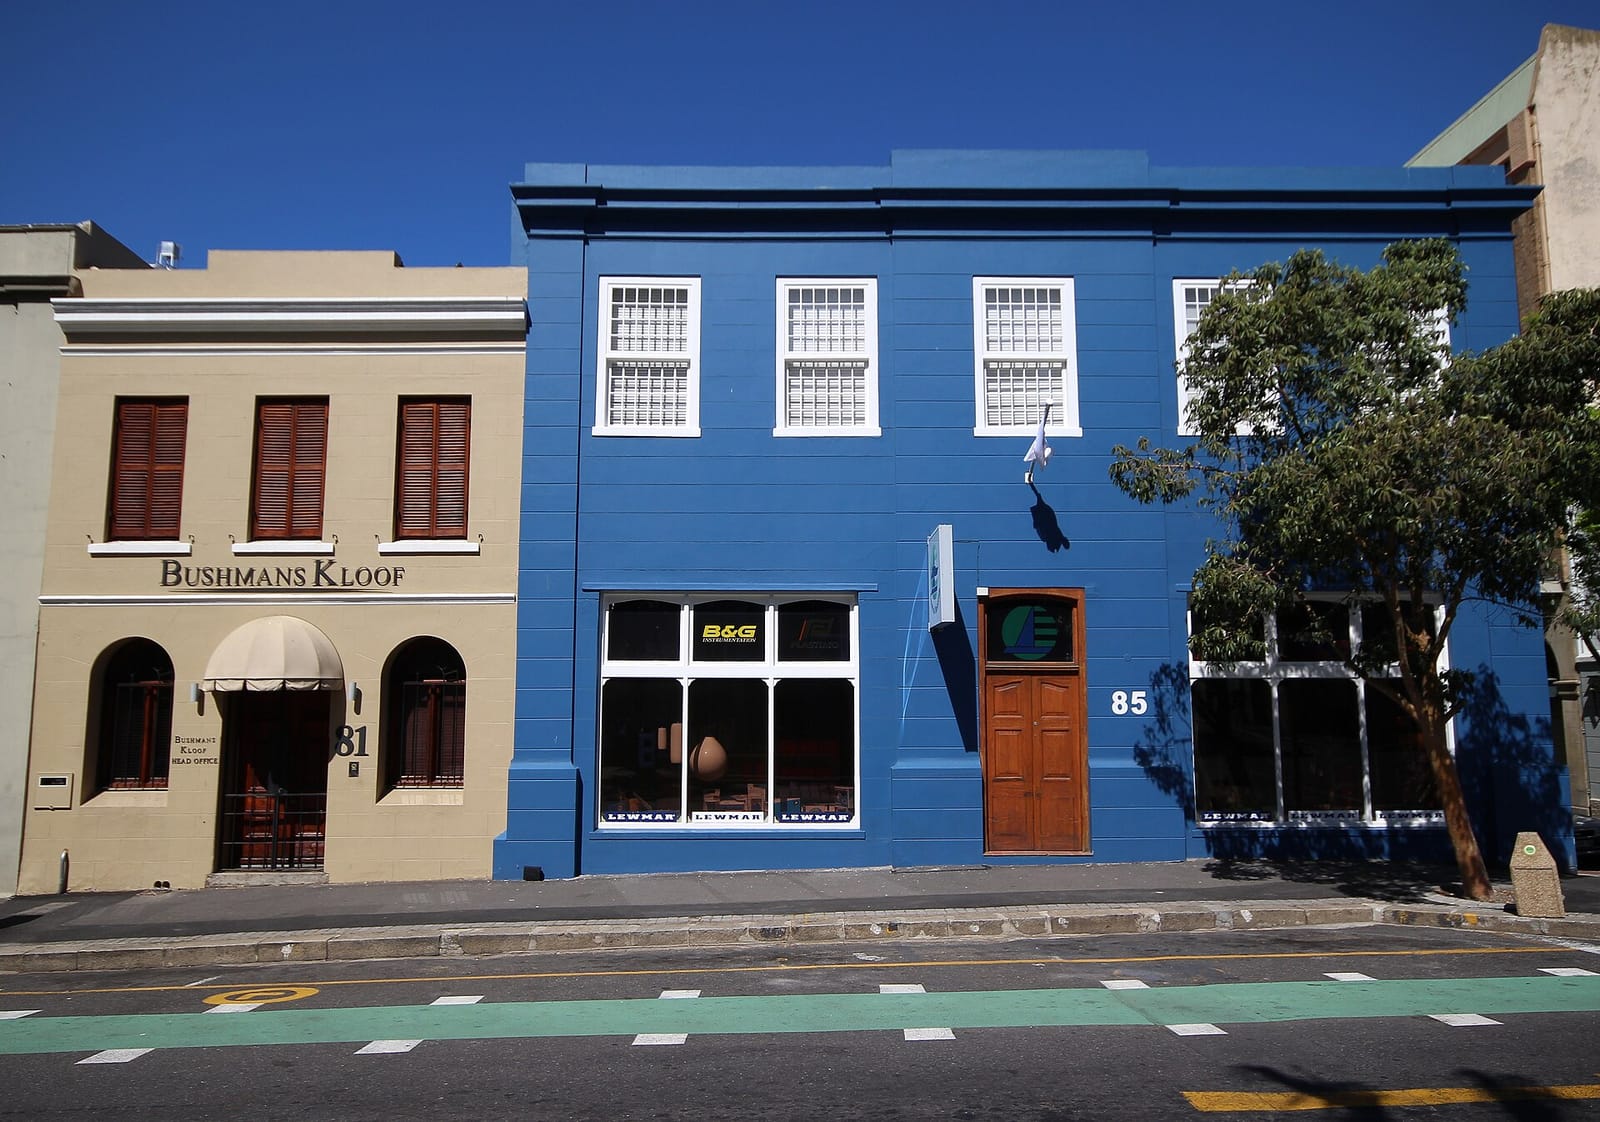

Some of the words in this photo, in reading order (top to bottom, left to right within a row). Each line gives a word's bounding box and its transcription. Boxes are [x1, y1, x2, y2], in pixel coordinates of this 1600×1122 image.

[160, 559, 306, 587] BUSHMANS
[312, 559, 405, 587] KLOOF
[702, 625, 757, 638] B&G
[1111, 690, 1148, 715] 85
[175, 735, 216, 744] BUSHMANS
[335, 725, 369, 757] 81
[180, 746, 207, 754] KLOOF
[171, 757, 192, 765] HEAD
[193, 757, 219, 765] OFFICE
